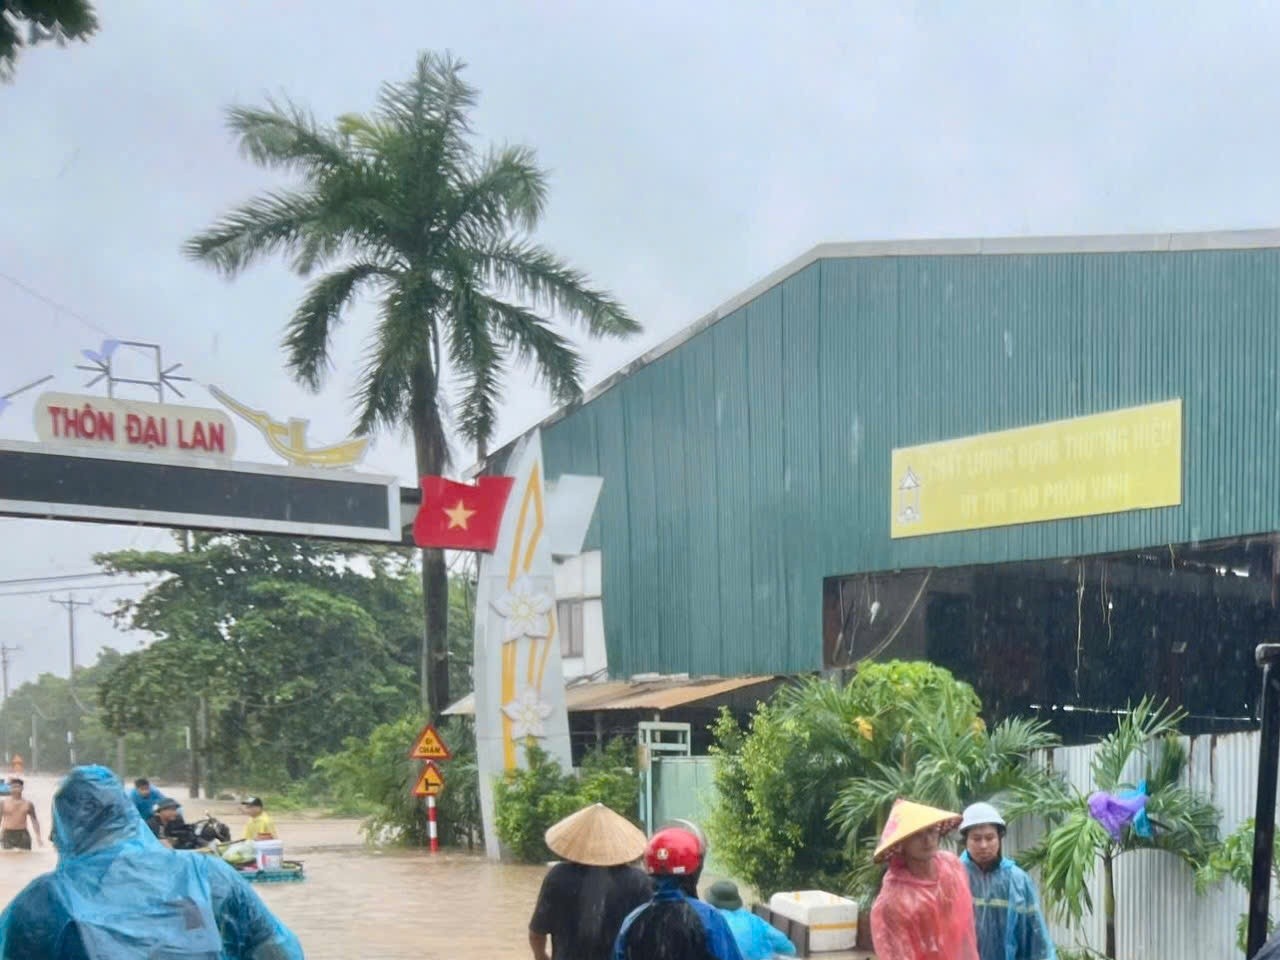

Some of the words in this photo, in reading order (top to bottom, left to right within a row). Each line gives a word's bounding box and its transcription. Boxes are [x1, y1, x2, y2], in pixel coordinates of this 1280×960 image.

[47, 402, 115, 441] THÔN
[125, 413, 168, 450] ĐẠI
[177, 419, 225, 452] LAN
